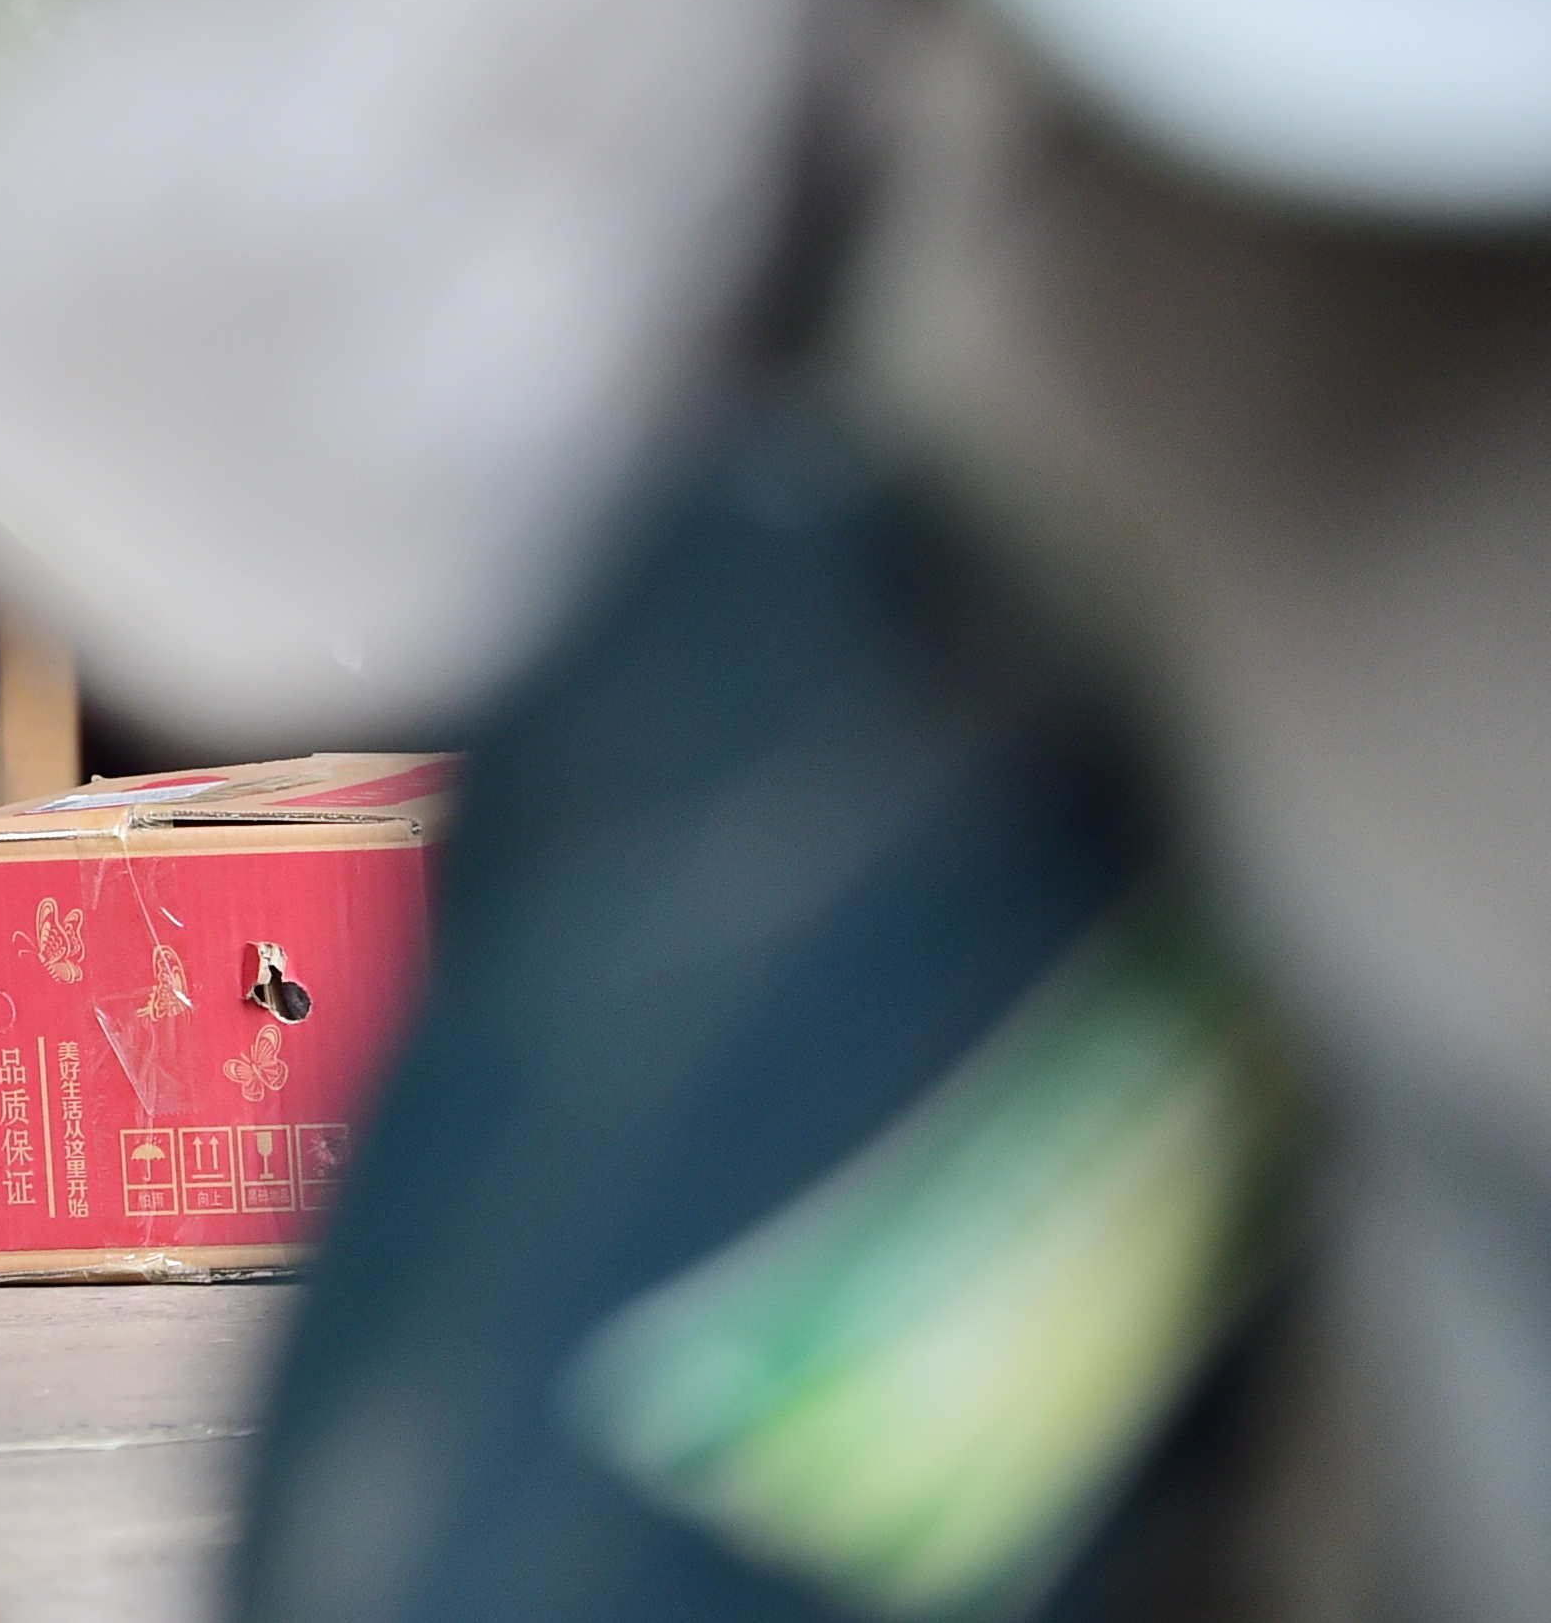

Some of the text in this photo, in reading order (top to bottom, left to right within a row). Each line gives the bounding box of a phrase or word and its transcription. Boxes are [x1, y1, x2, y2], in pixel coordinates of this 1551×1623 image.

[57, 1040, 90, 1219] 美好生活从这里开始
[197, 1192, 224, 1207] 向上
